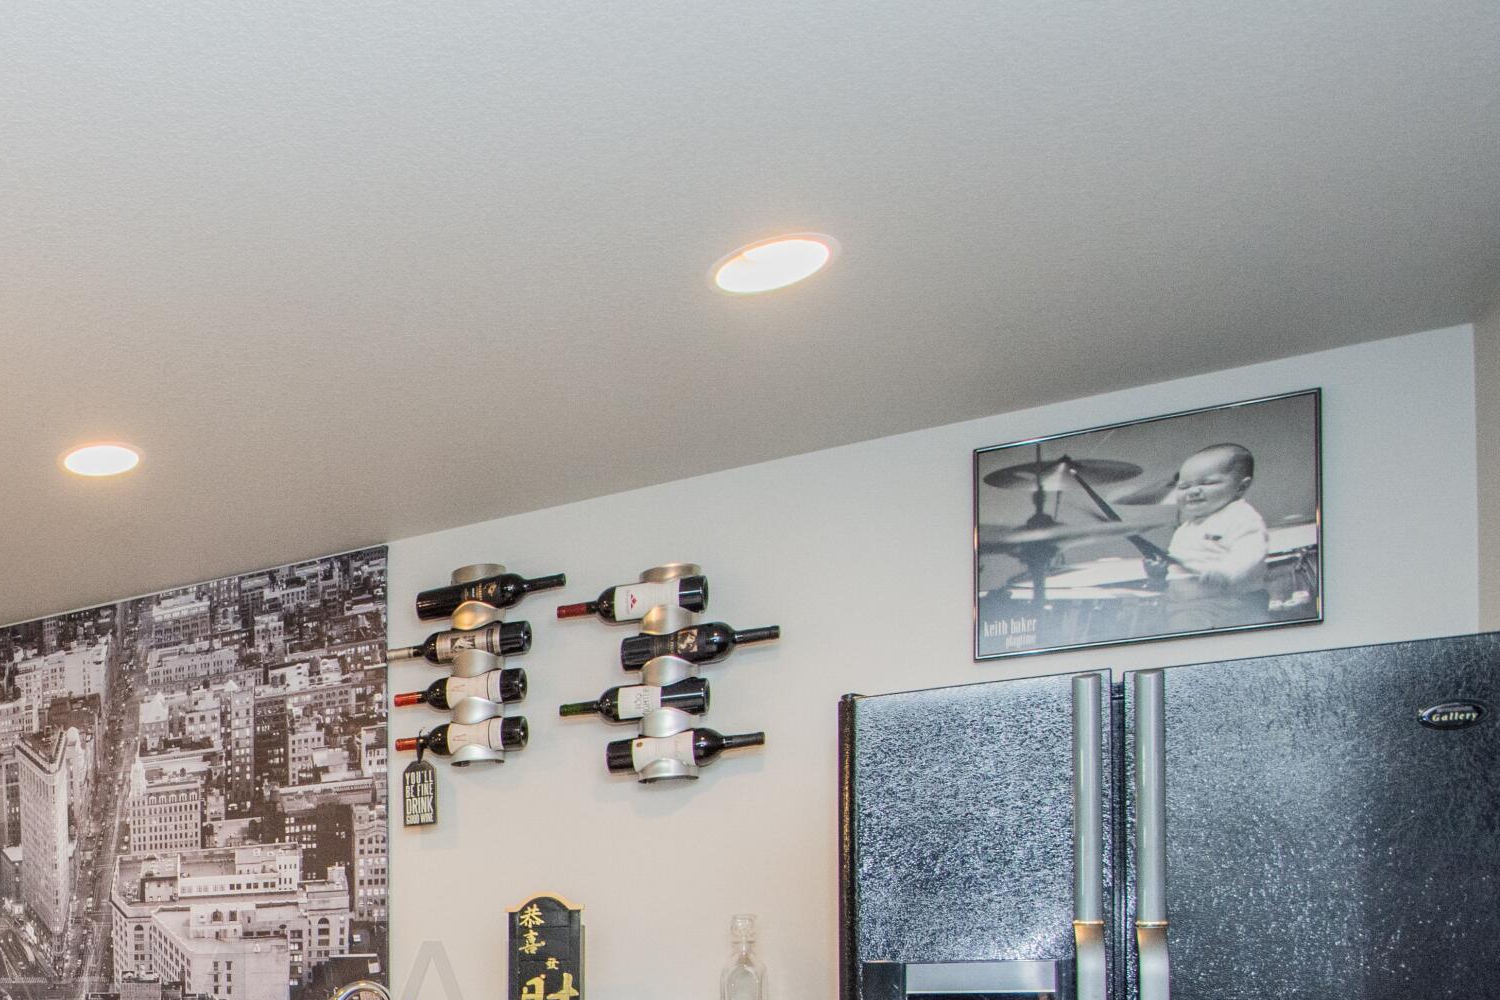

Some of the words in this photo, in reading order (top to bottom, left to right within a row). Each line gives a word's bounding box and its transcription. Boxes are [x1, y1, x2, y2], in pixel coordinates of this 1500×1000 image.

[1010, 617, 1036, 633] baker
[1431, 712, 1478, 721] Gallery
[405, 770, 433, 785] YOU'LL
[405, 785, 415, 798] BE
[417, 783, 433, 796] FINE
[406, 796, 433, 815] DRINK
